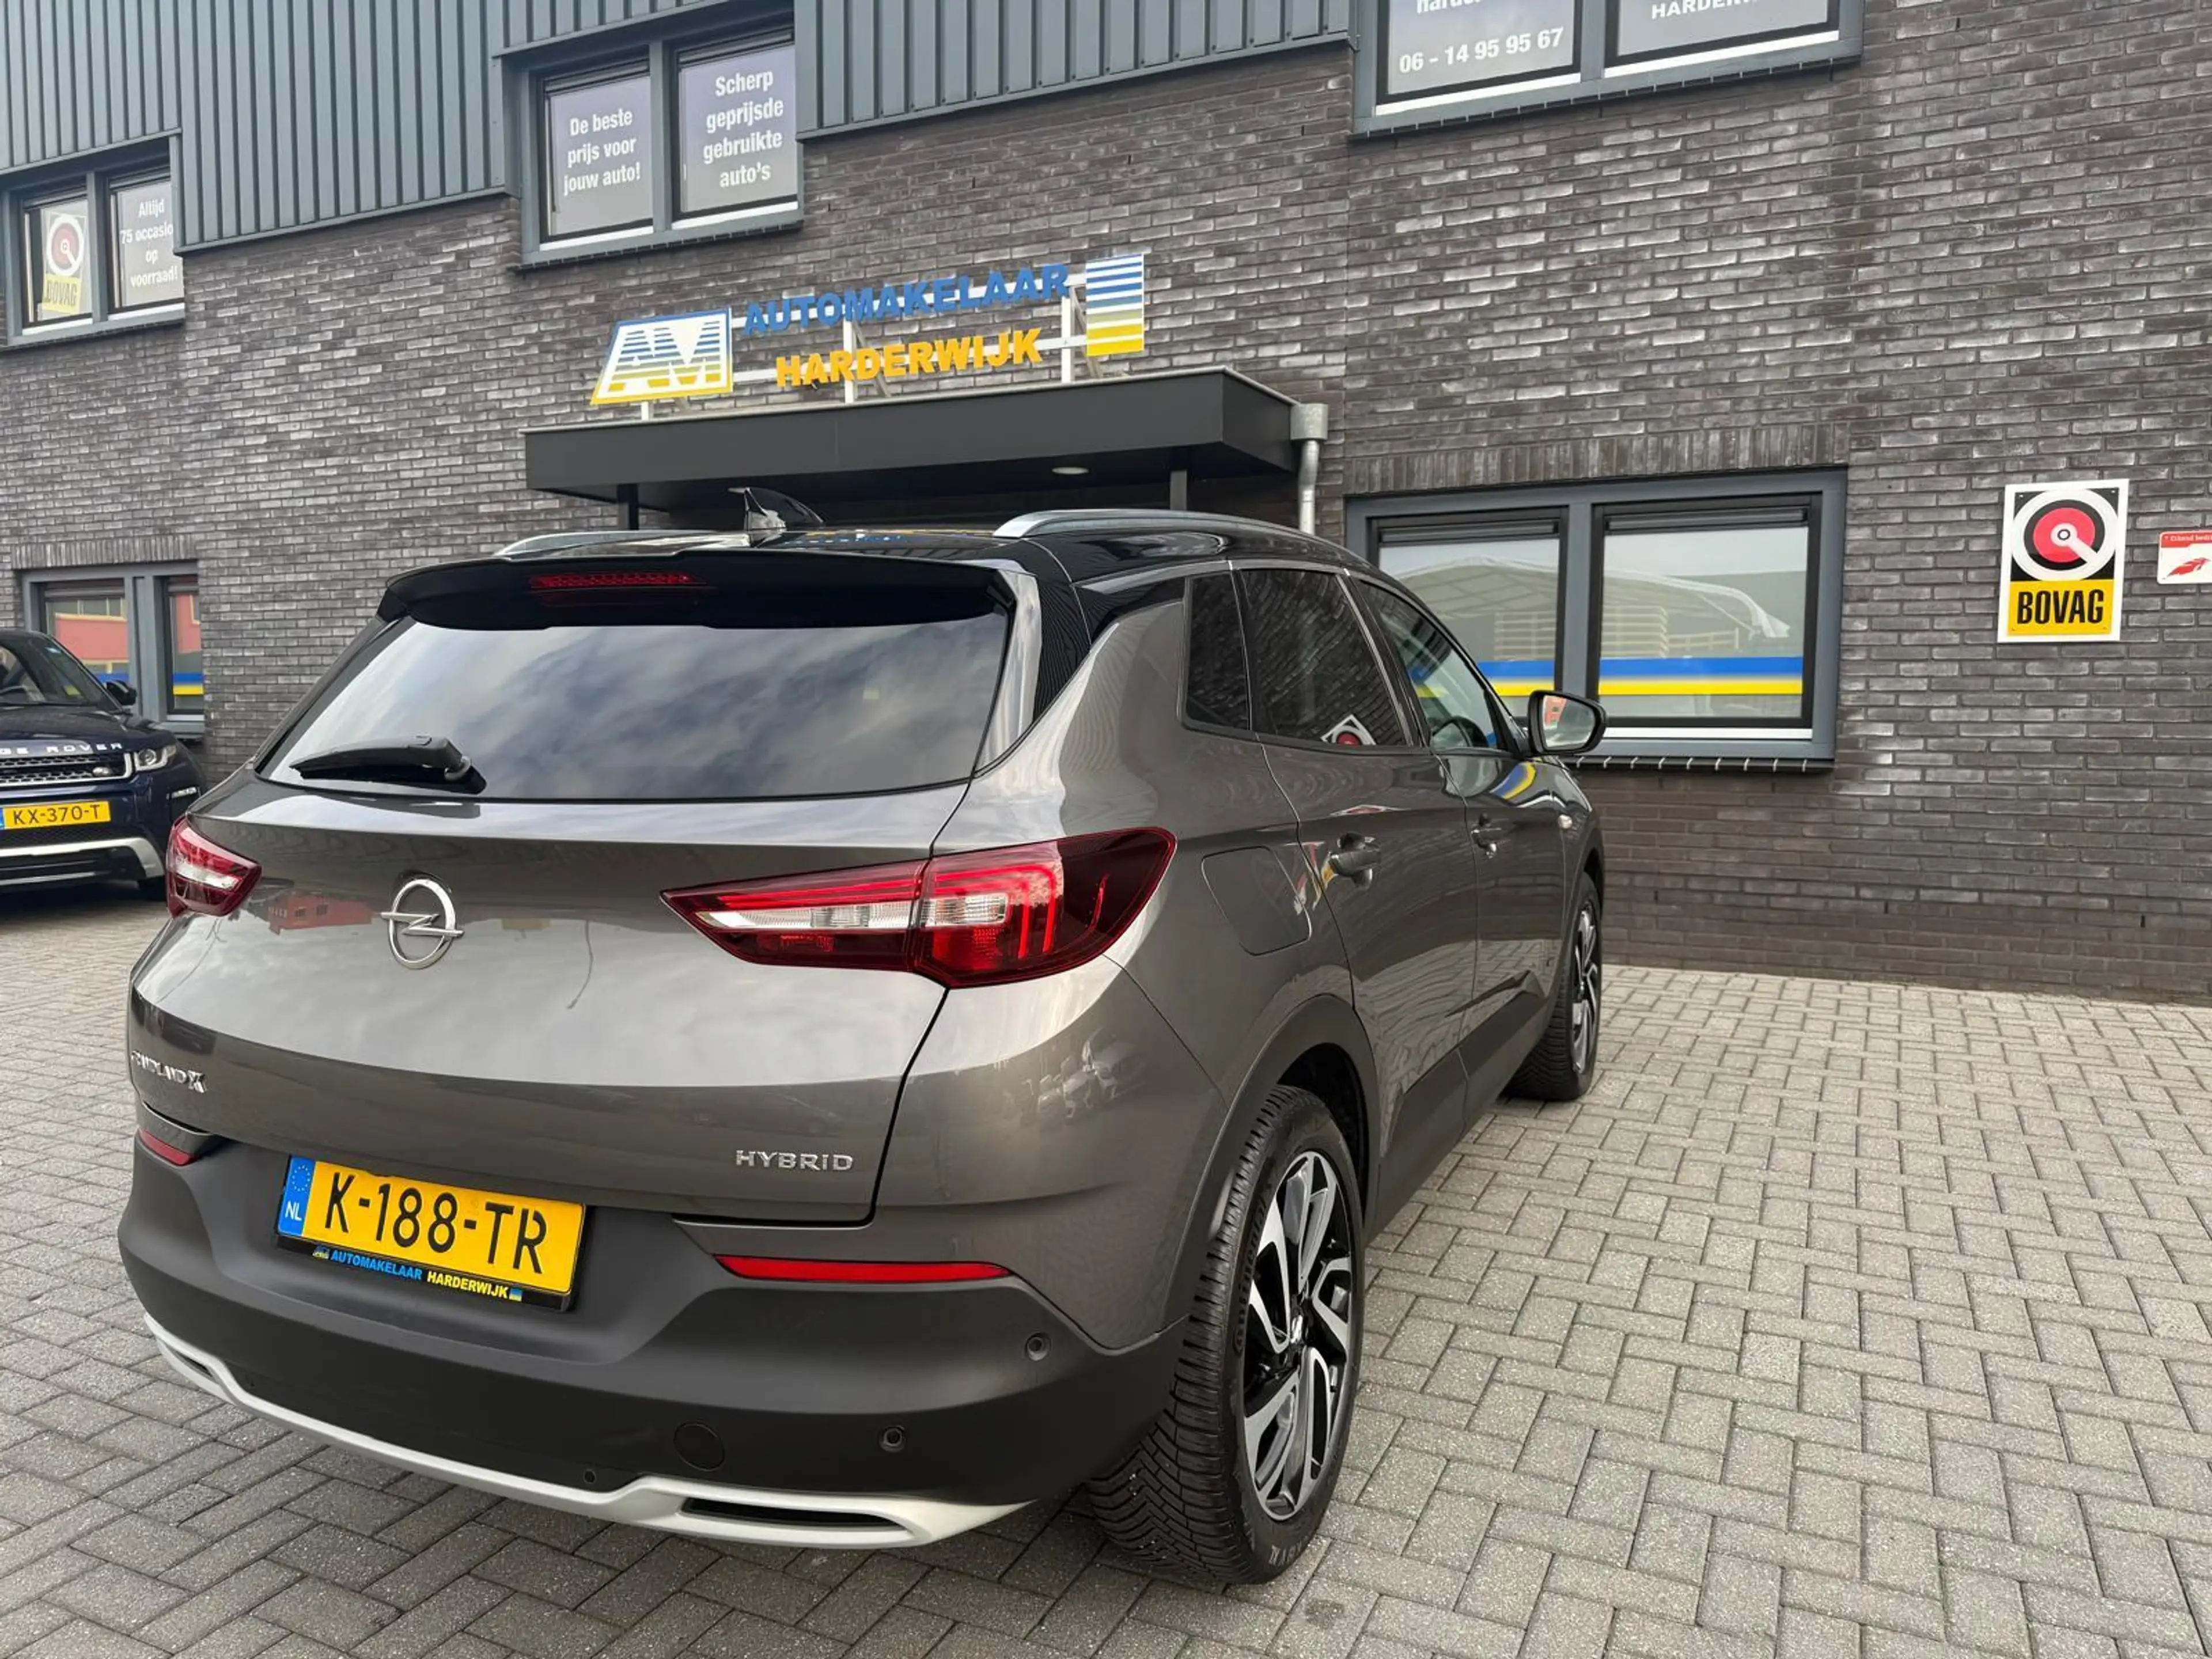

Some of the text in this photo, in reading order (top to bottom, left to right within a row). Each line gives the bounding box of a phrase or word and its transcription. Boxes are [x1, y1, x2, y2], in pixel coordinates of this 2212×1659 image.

[1399, 52, 1424, 73] 06
[1445, 44, 1469, 65] 14
[1475, 38, 1499, 60] 95
[1506, 33, 1531, 55] 95
[1537, 26, 1563, 50] 67
[715, 70, 774, 97] Scherp
[570, 109, 632, 137] De beste
[706, 97, 784, 134] geprijsde
[567, 137, 637, 168] prijs voor
[703, 129, 783, 165] gebruikte
[563, 162, 640, 197] jouw auto!
[719, 162, 772, 188] auto's
[138, 198, 165, 218] Altijd
[120, 229, 133, 244] 75
[145, 249, 158, 264] op
[130, 265, 178, 287] voorraad!
[743, 264, 1070, 336] AUTOMAKELAAR
[775, 327, 1043, 388] HARDERWIJK
[2017, 589, 2104, 625] BOVAG
[46, 743, 122, 753] ROVER
[13, 804, 100, 825] KX-370-T
[736, 1150, 853, 1171] HYBRID
[285, 1200, 302, 1222] NL
[324, 1172, 547, 1274] K-188-TR
[331, 1249, 423, 1281] AUTOMAKELAAR
[427, 1271, 509, 1299] HARDERWIJK
